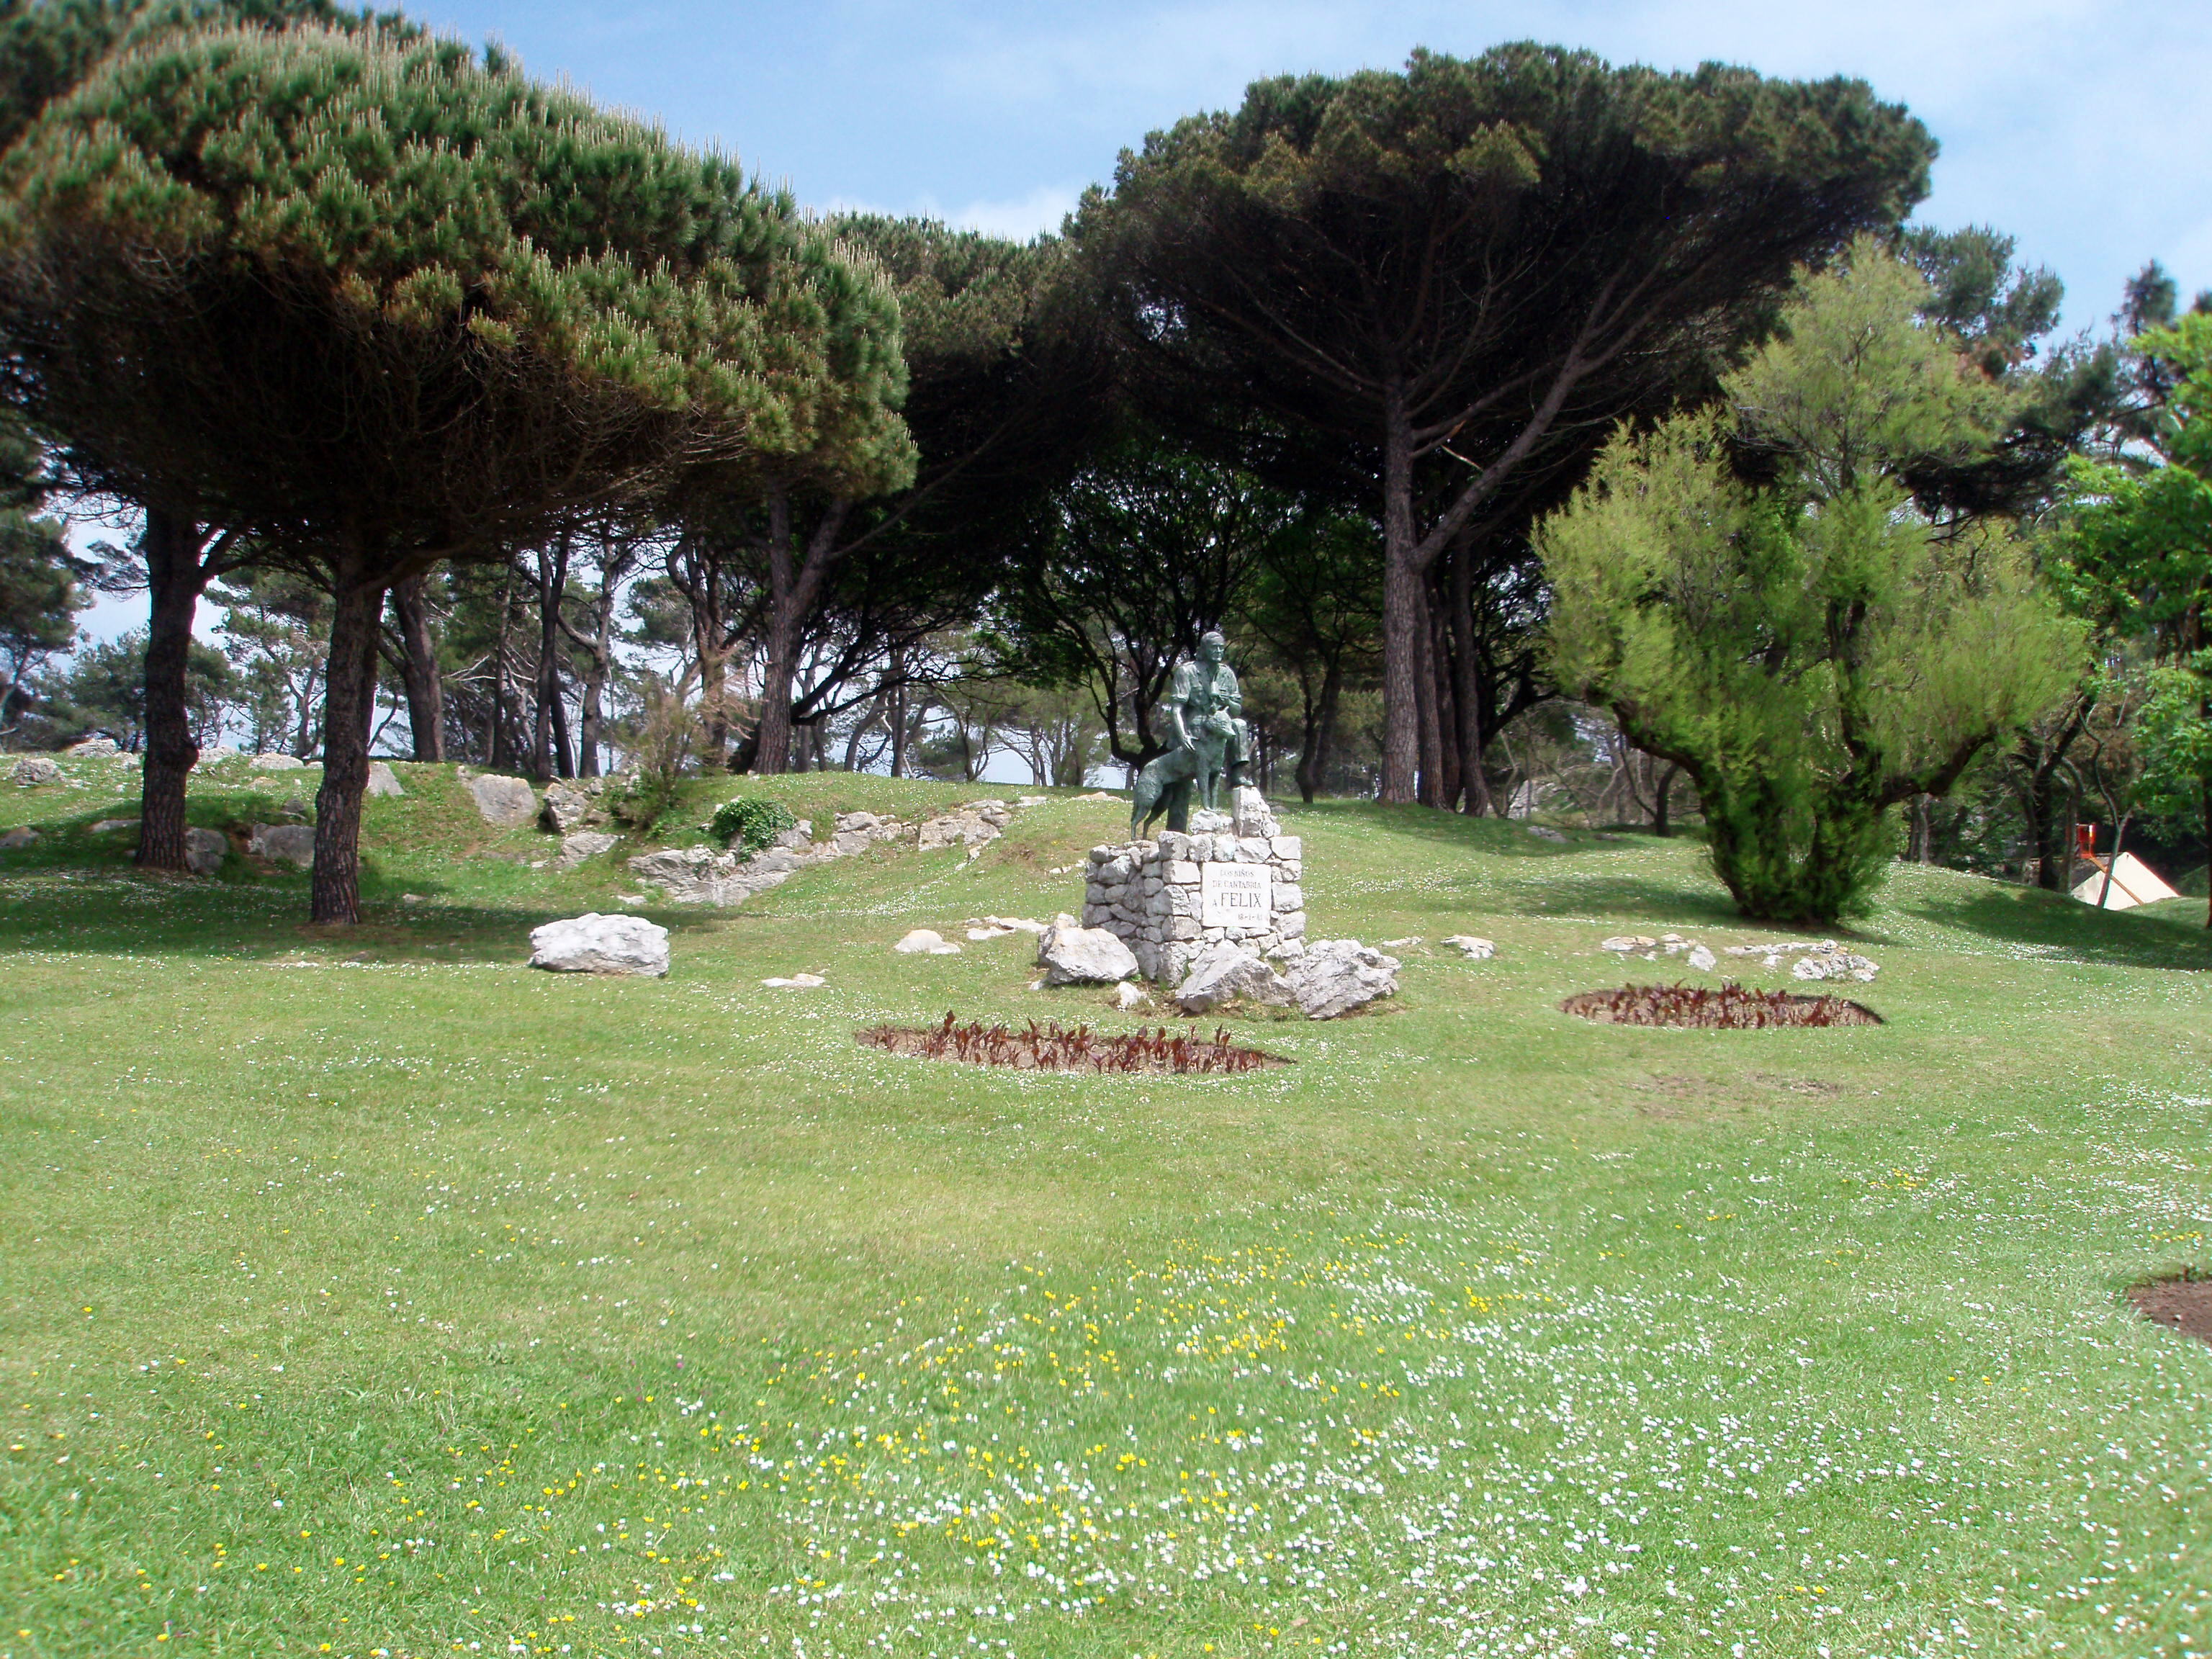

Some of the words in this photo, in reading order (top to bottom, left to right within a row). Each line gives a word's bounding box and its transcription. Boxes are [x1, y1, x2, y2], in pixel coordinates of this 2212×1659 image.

[1224, 881, 1262, 889] CANTABRIA
[1213, 899, 1218, 907] A
[1221, 892, 1262, 908] FELIX
